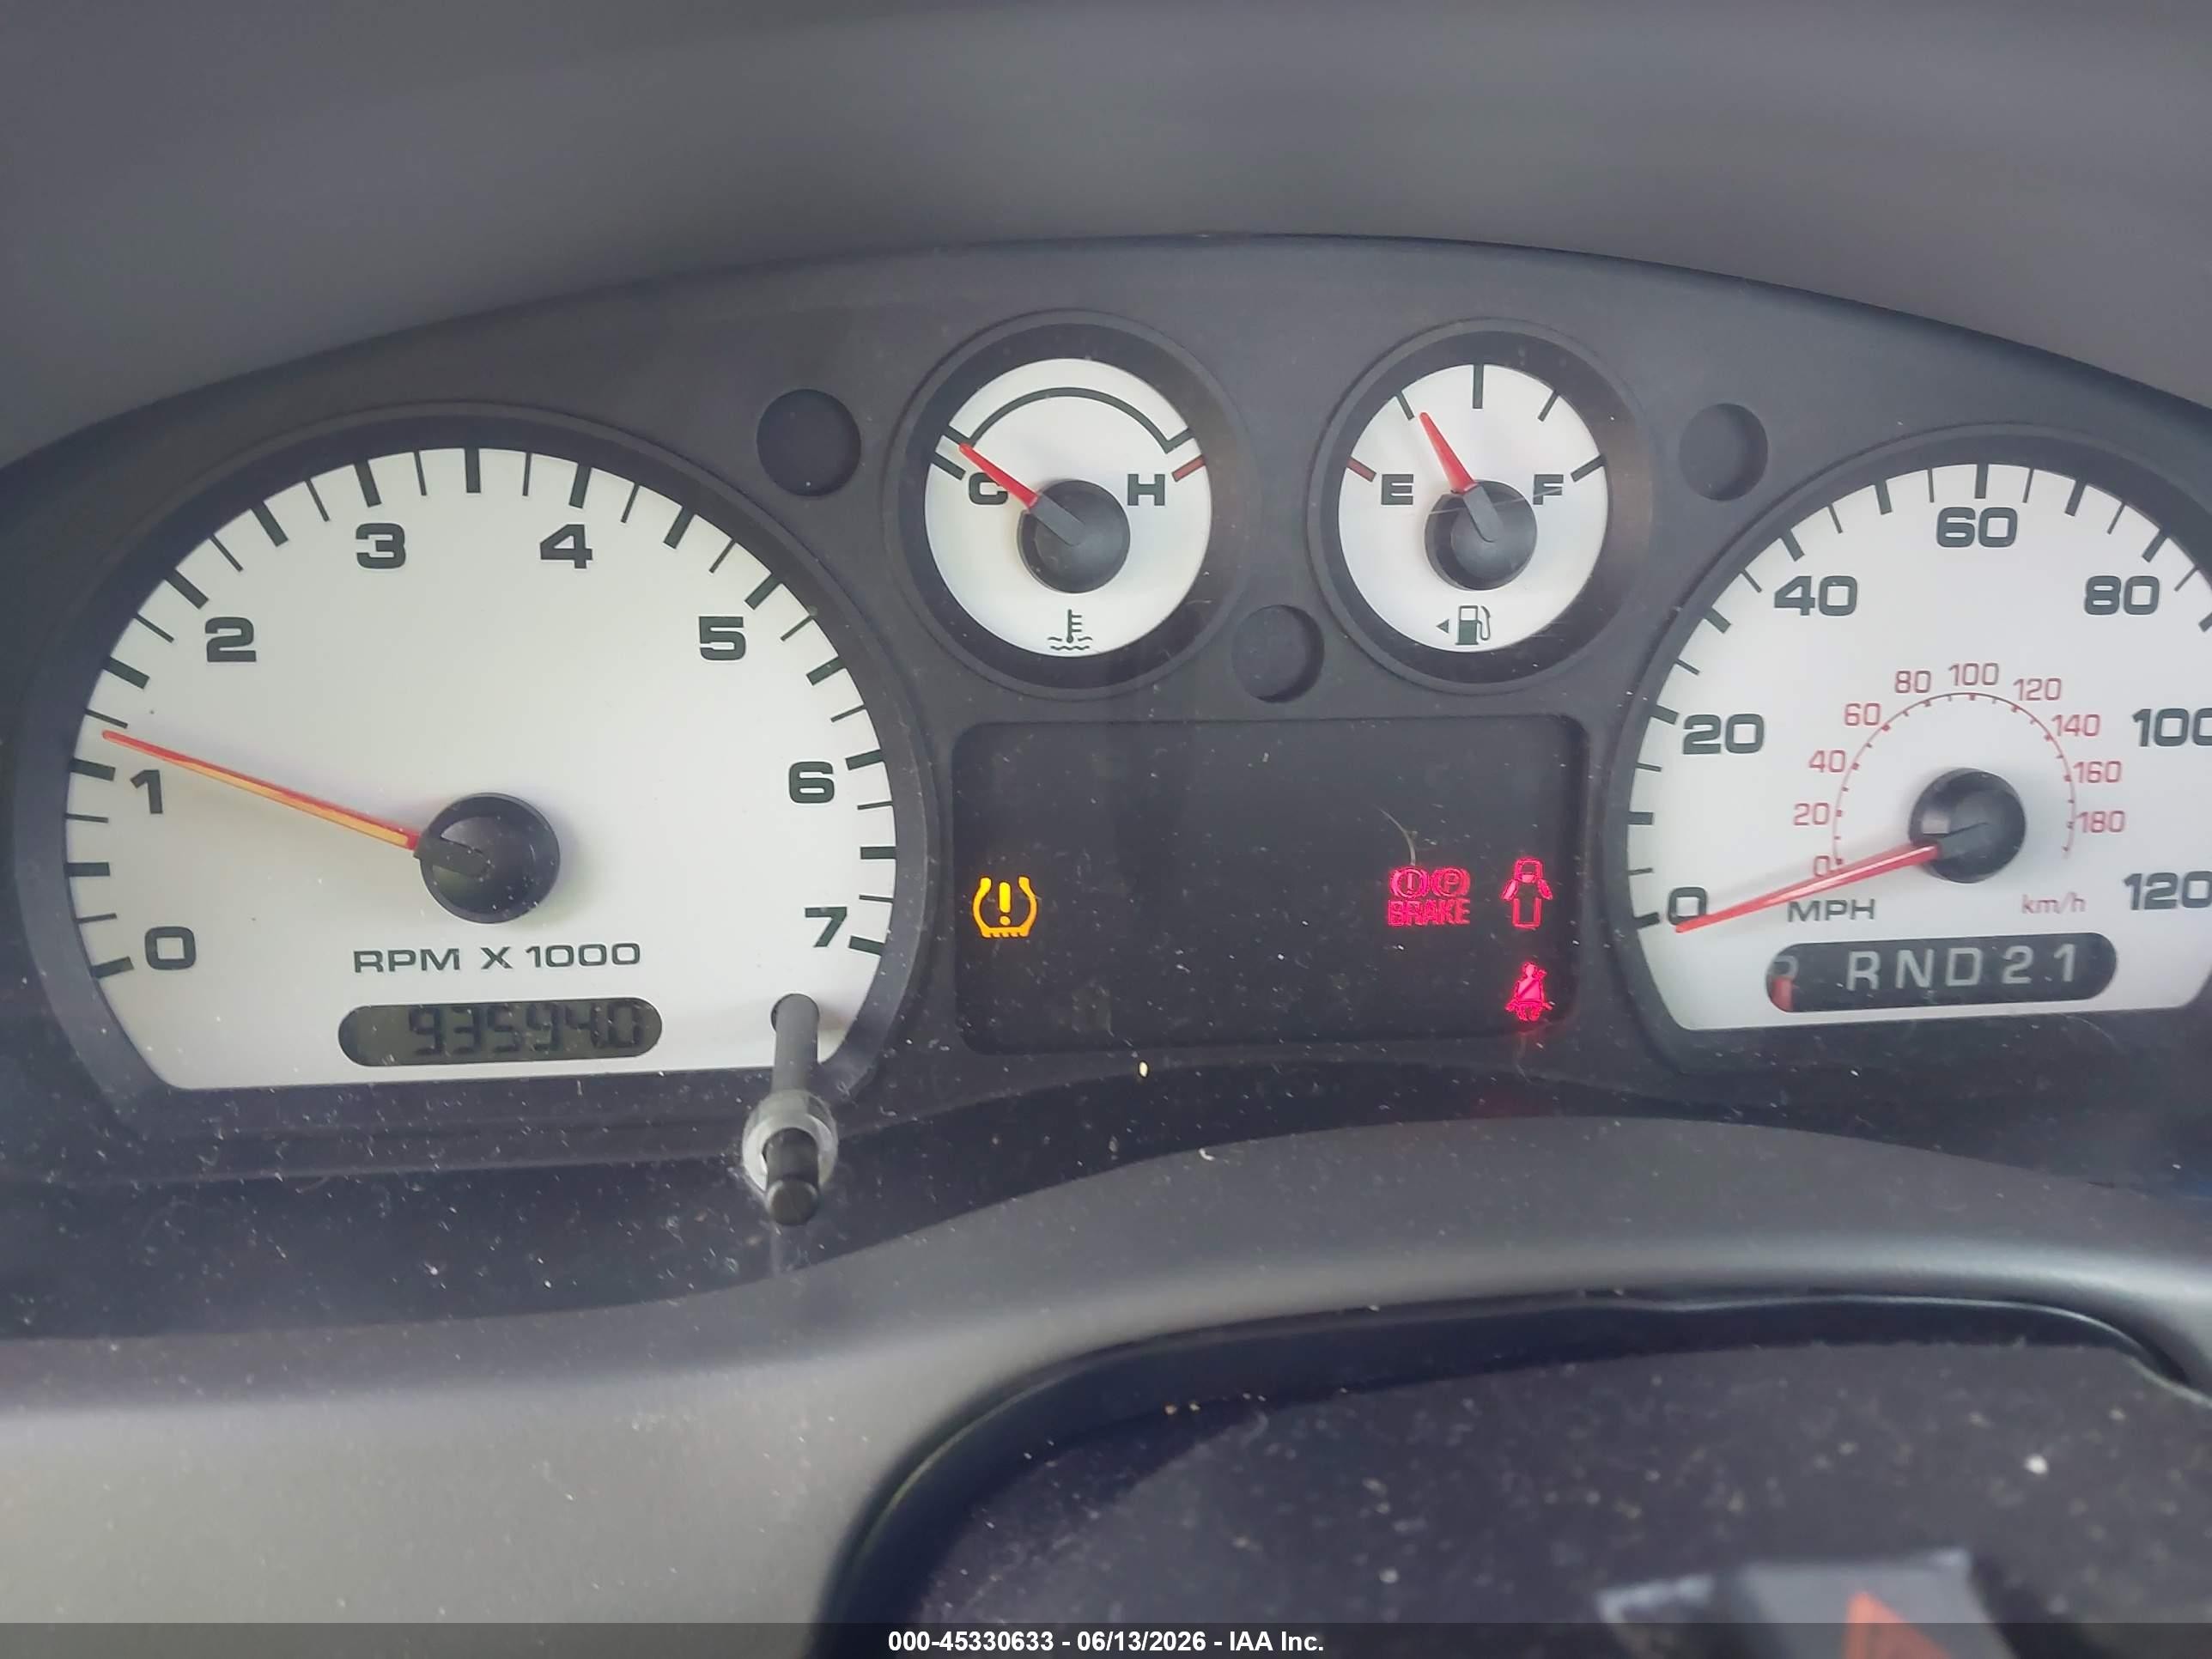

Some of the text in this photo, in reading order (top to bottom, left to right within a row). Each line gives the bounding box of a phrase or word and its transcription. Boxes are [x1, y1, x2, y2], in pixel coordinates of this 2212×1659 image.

[968, 474, 1009, 505] C
[1127, 474, 1165, 506] H
[1381, 474, 1413, 505] E
[1533, 474, 1564, 505] F
[1936, 507, 2017, 547] 60
[356, 523, 406, 568] 3
[539, 524, 592, 568] 4
[1774, 575, 1857, 616] 40
[2084, 575, 2160, 615] 80
[204, 617, 257, 662] 2
[698, 616, 746, 660] 5
[1894, 670, 1931, 693] 80
[1948, 663, 1999, 686] 100
[2013, 678, 2062, 701] 120
[1844, 703, 1881, 726] 60
[2052, 714, 2100, 737] 140
[1683, 714, 1764, 754] 20
[1808, 750, 1846, 773] 40
[2073, 761, 2123, 783] 160
[131, 769, 163, 814] 1
[788, 761, 835, 804] 6
[1793, 803, 1830, 825] 20
[2078, 811, 2125, 833] 180
[1667, 887, 1708, 925] 0
[2021, 894, 2087, 915] km/h
[2124, 871, 2212, 910] 120
[1388, 898, 1470, 926] BRAKE
[1788, 899, 1875, 922] MPH
[805, 907, 848, 947] 7
[144, 927, 197, 970] 0
[354, 943, 641, 973] RPM X 1000
